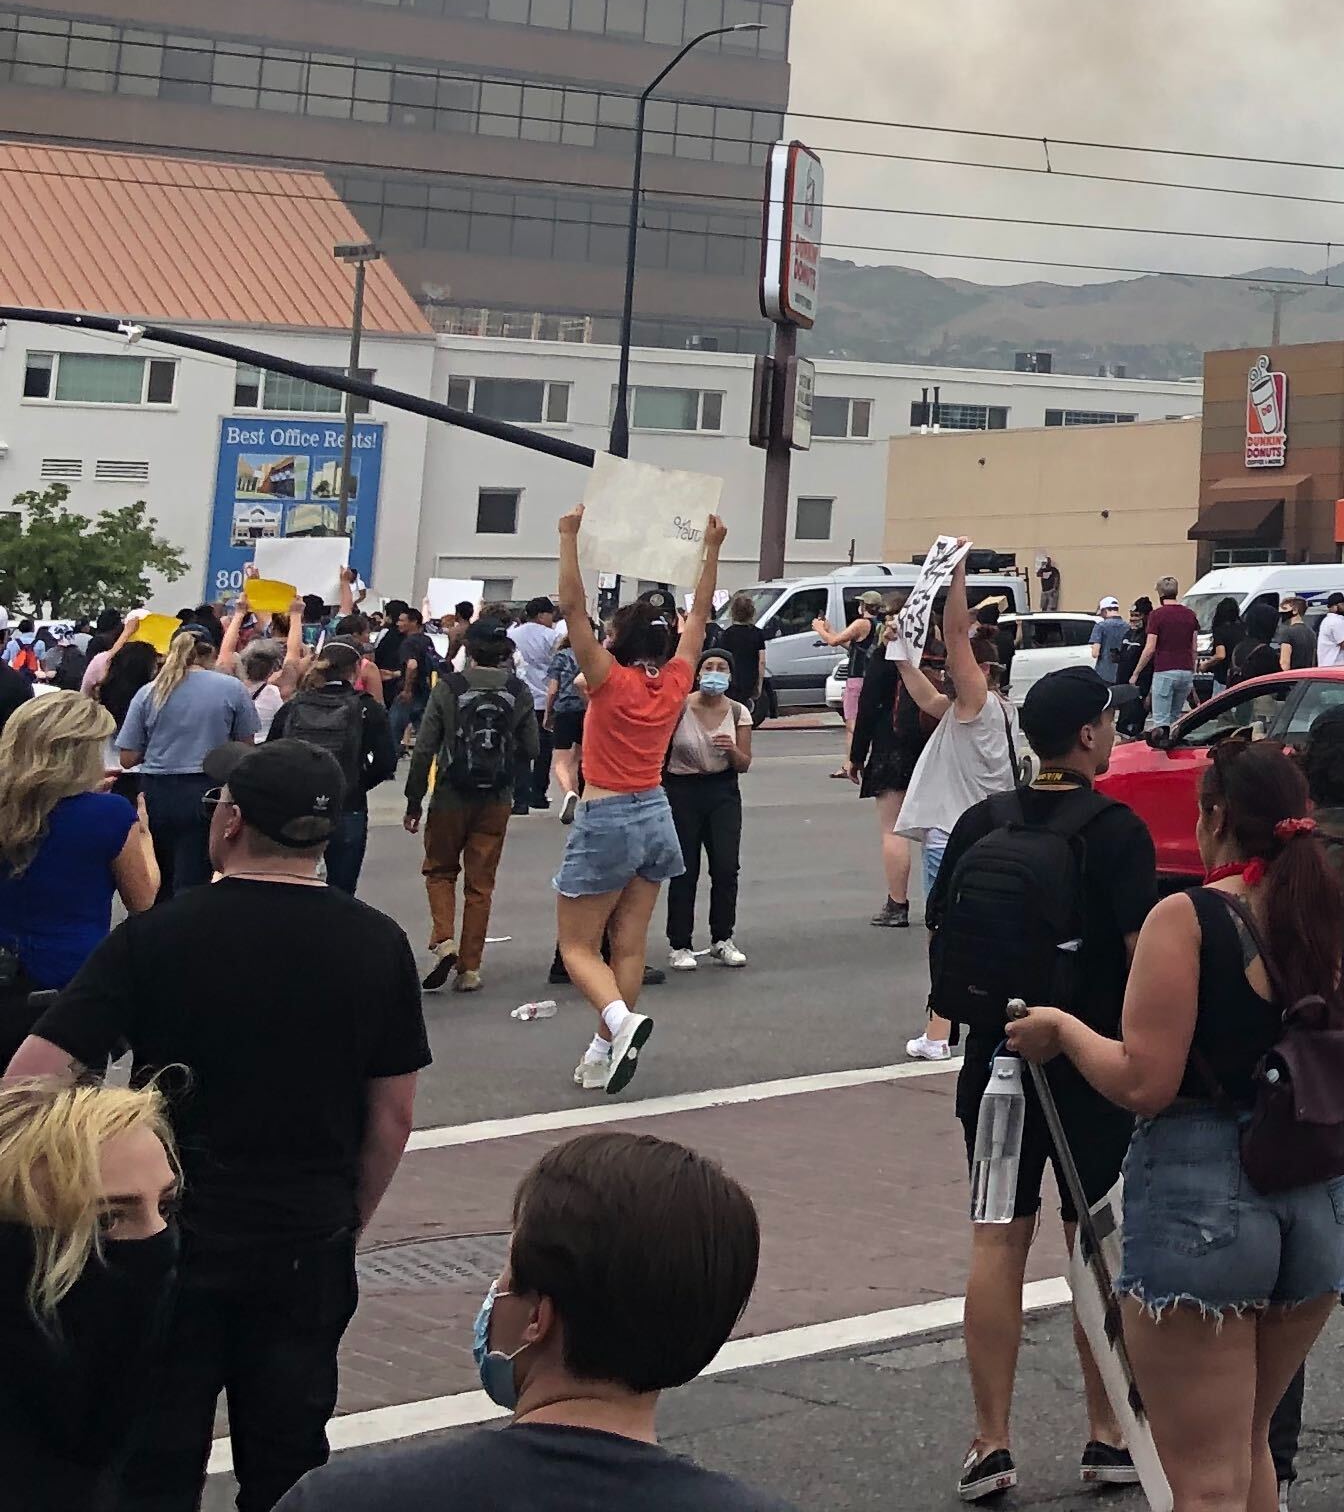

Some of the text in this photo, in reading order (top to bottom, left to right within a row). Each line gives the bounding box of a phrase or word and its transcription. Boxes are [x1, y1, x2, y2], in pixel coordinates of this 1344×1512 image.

[227, 426, 266, 445] Best
[270, 428, 320, 448] Office
[1246, 447, 1282, 458] DONUTS
[216, 570, 242, 589] 80
